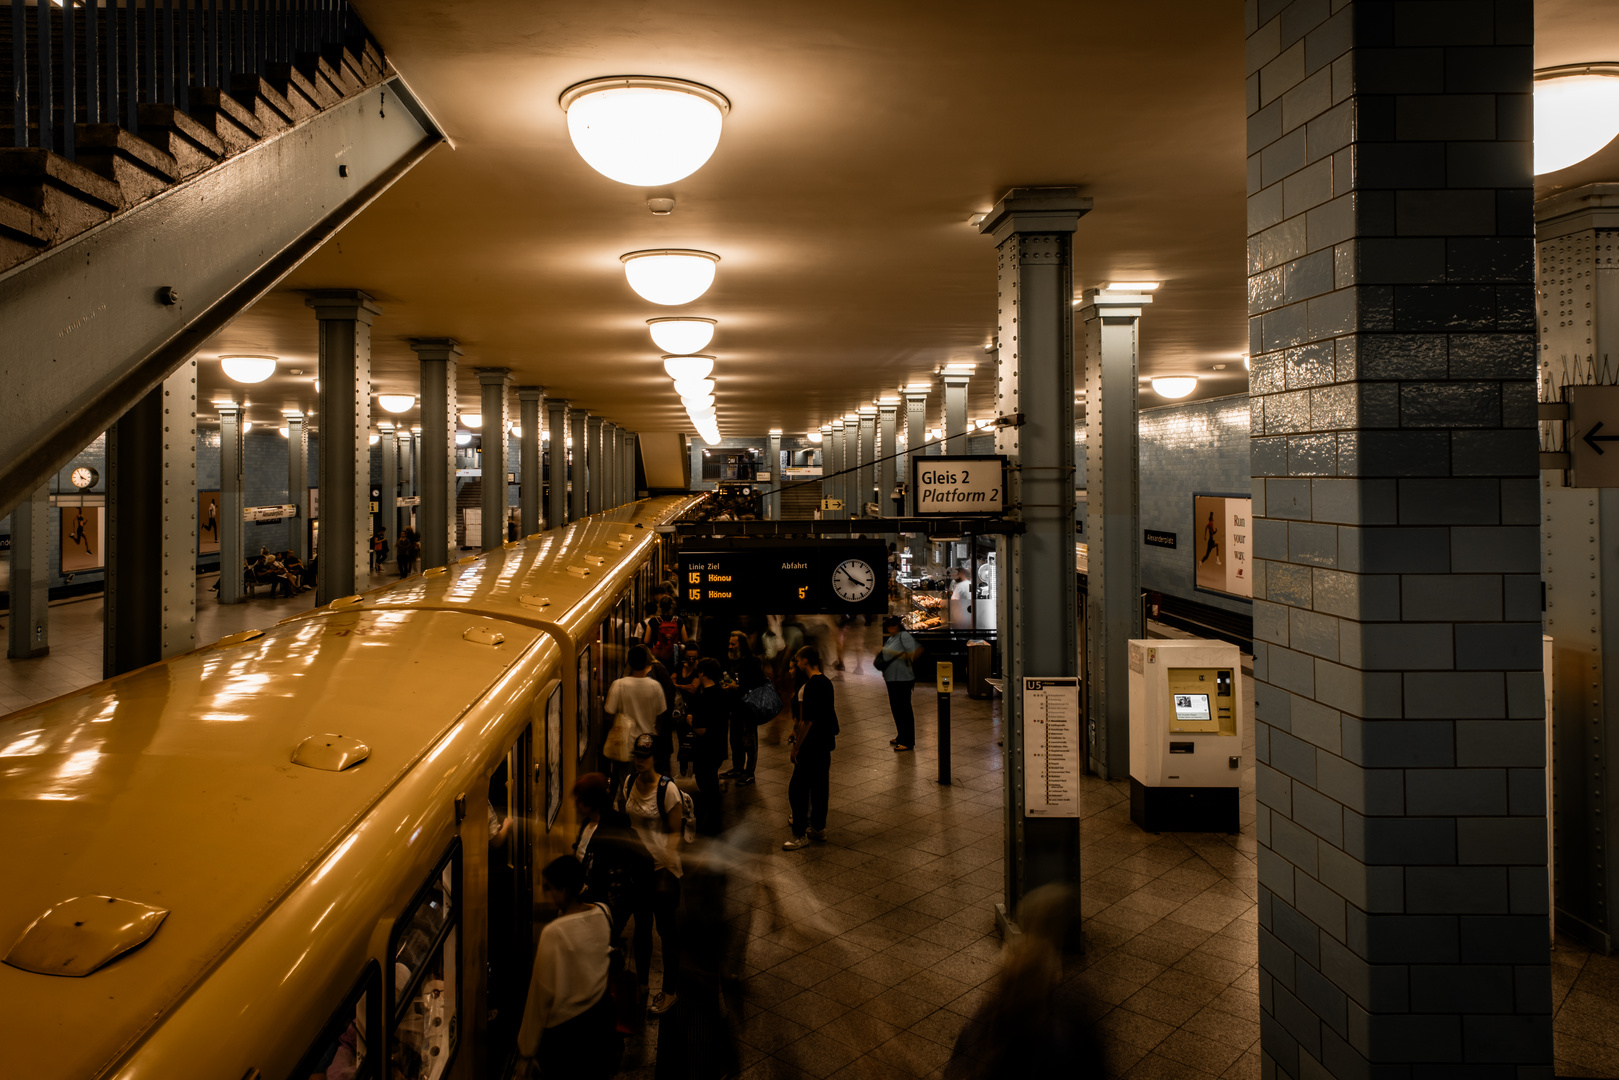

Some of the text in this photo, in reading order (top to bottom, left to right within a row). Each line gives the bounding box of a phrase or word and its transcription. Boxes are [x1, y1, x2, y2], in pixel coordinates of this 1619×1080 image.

[922, 470, 970, 484] Gleis 2
[922, 488, 999, 502] Platform 2
[1233, 514, 1245, 527] Run
[1146, 533, 1174, 545] Alexanderplatz
[1233, 533, 1246, 546] your
[689, 562, 808, 571] Linie Ziel Abfahrt
[688, 572, 732, 584] U5 Hönow
[688, 588, 701, 600] U5
[708, 590, 732, 599] Hönow
[1027, 681, 1042, 690] U5
